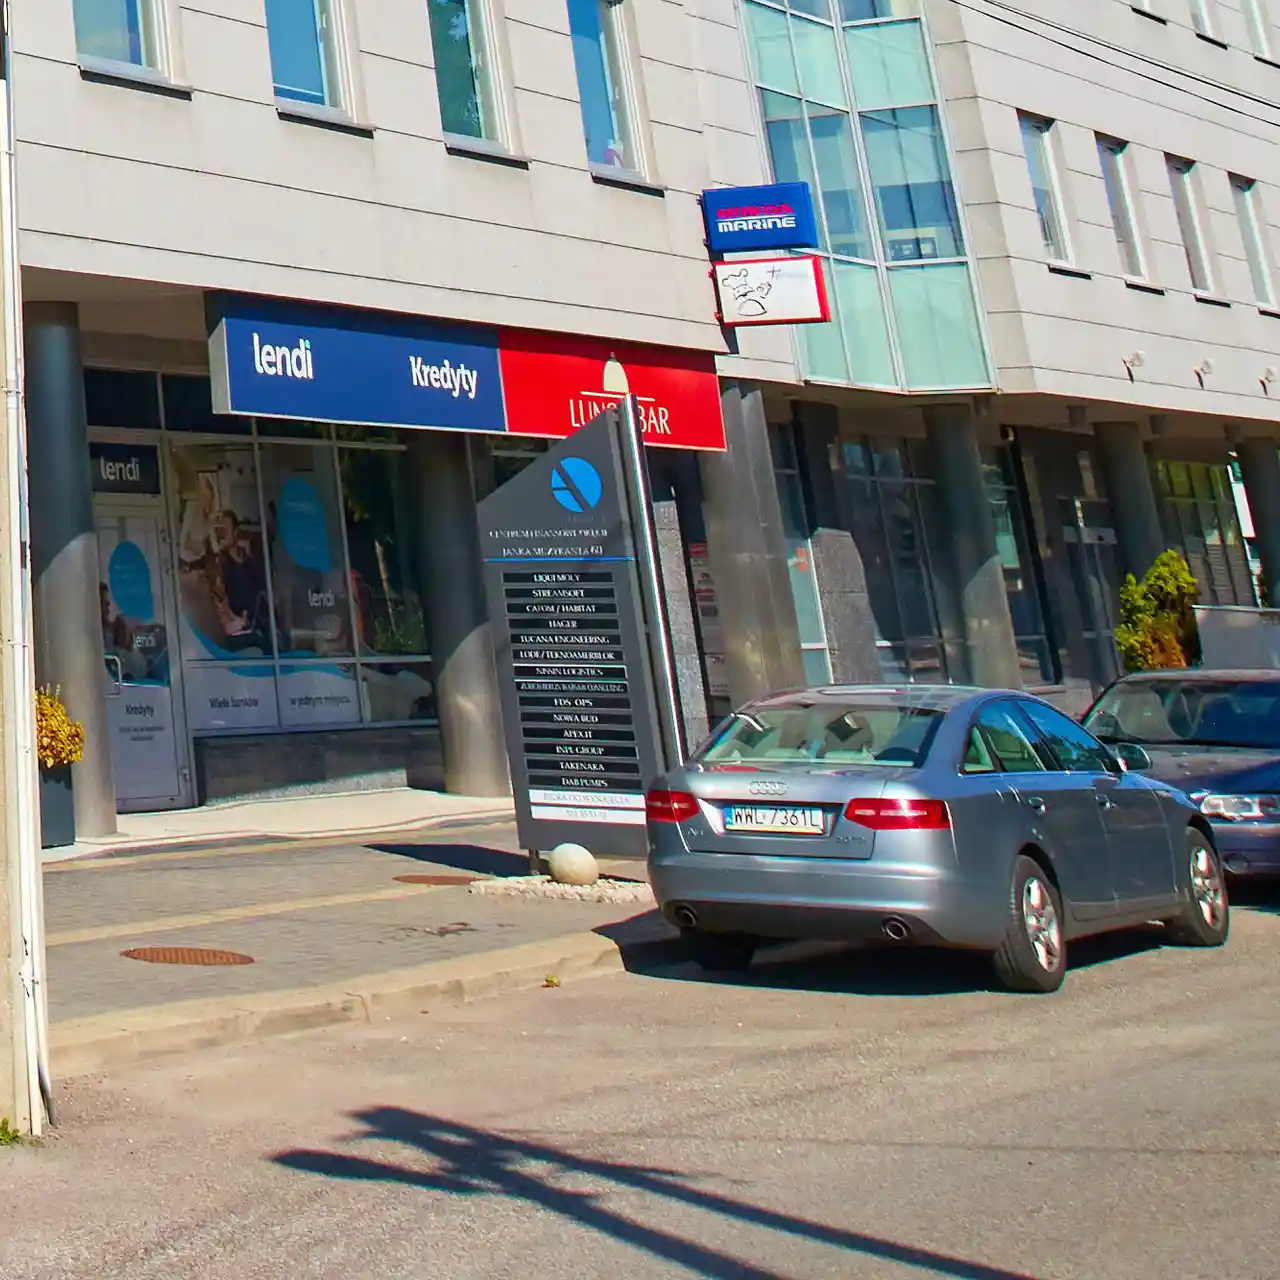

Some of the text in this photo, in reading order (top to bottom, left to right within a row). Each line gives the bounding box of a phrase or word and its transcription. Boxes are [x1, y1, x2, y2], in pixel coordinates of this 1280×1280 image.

[717, 217, 796, 233] MARINE
[252, 332, 477, 399] lendi Kredyty
[637, 405, 672, 435] BAR
[100, 455, 140, 481] lendi
[559, 761, 605, 771] TAKENAKA
[733, 806, 819, 827] WWL 7361L
